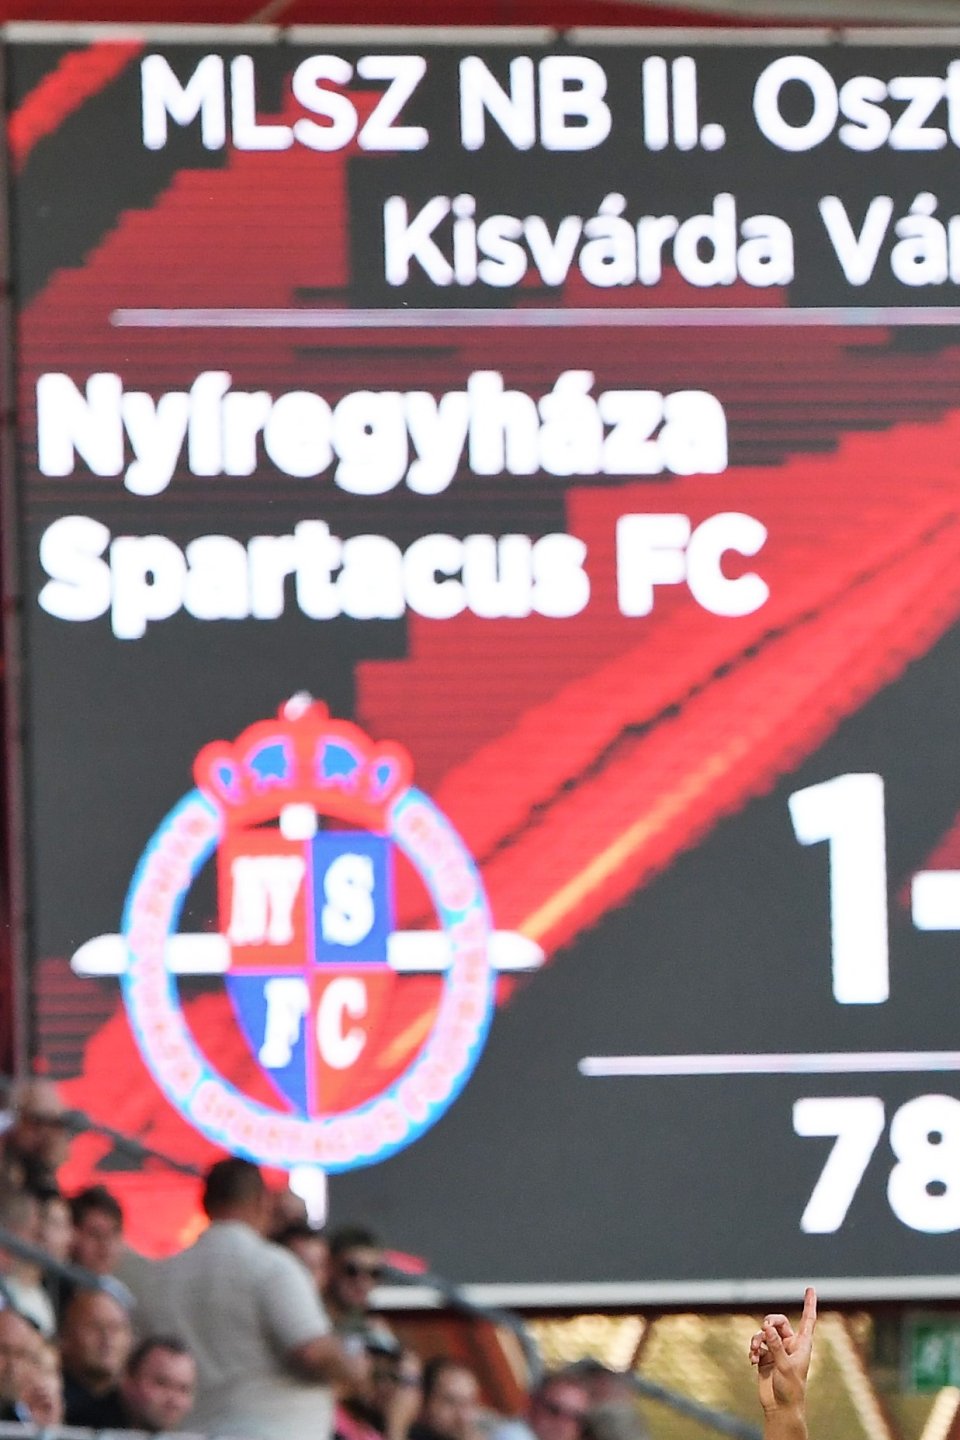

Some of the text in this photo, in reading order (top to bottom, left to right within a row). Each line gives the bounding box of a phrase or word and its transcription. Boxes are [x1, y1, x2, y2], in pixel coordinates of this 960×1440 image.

[142, 55, 428, 150] MLSZ
[459, 55, 612, 150] NB
[643, 56, 726, 150] II.
[384, 193, 795, 287] Kisvárda
[37, 371, 728, 495] Nyíregyháza
[39, 512, 769, 638] Spartacus FC
